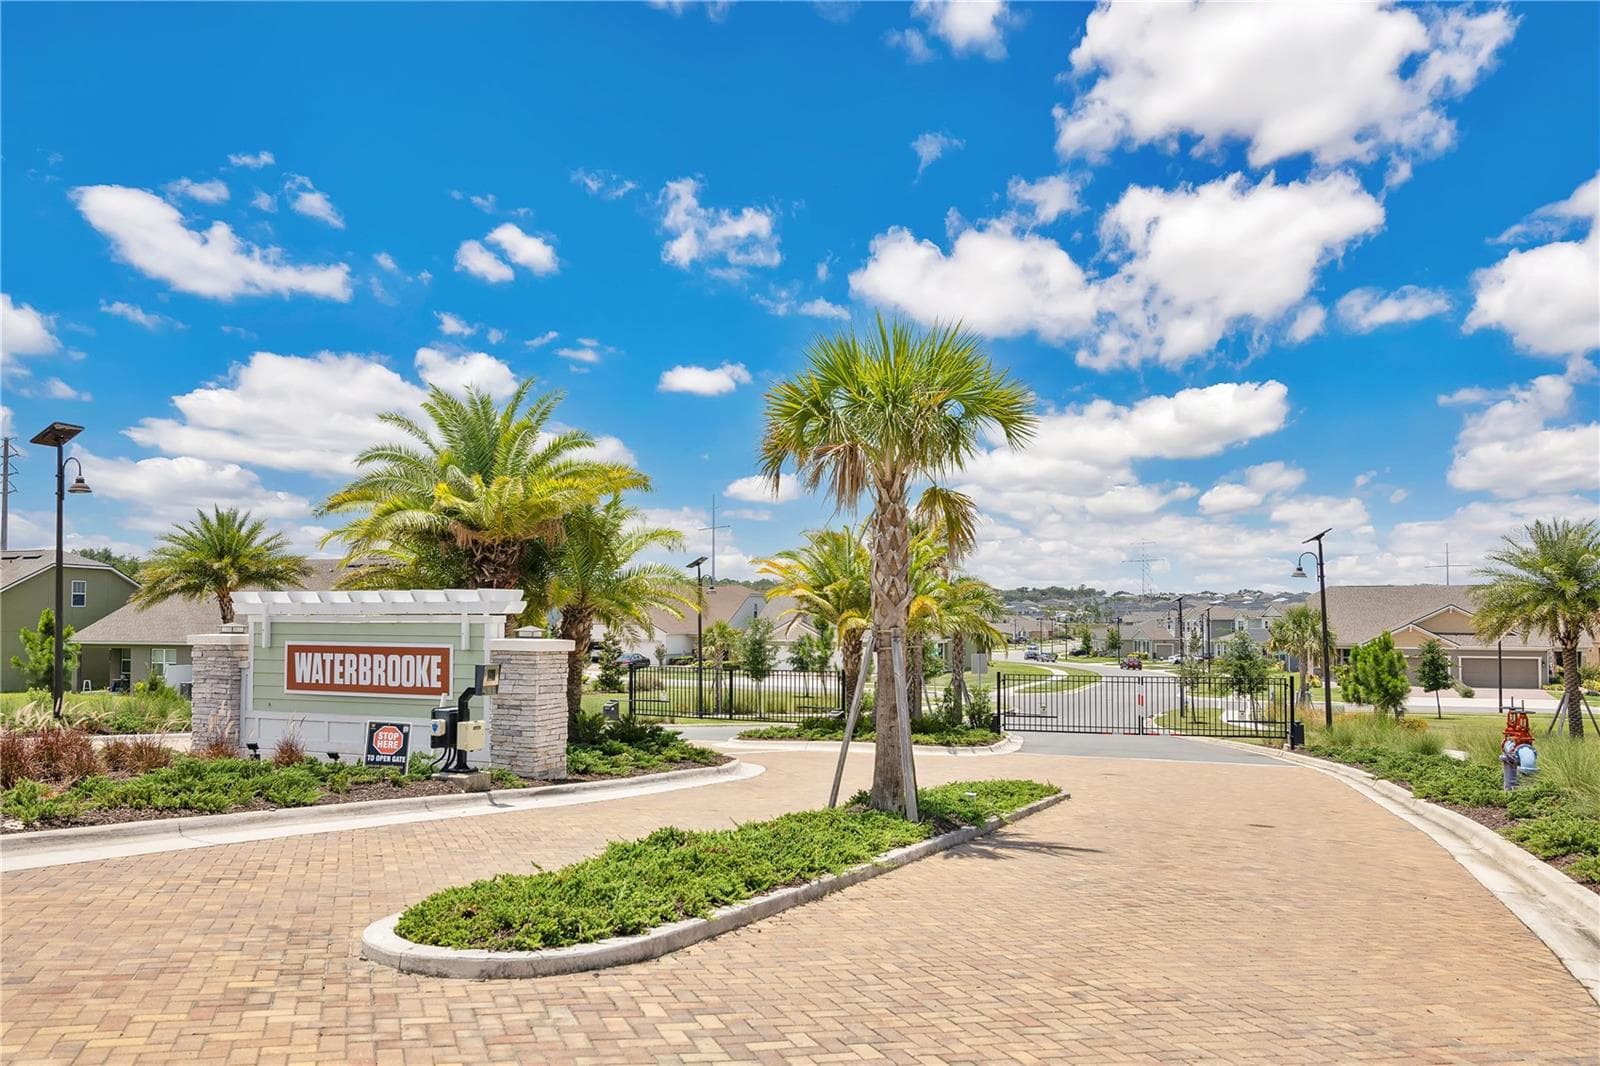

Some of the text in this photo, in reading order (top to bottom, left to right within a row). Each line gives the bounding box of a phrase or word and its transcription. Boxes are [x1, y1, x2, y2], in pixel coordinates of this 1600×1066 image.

[294, 652, 442, 688] WATERBROOKE
[378, 732, 399, 741] STOP
[377, 740, 399, 749] HERE
